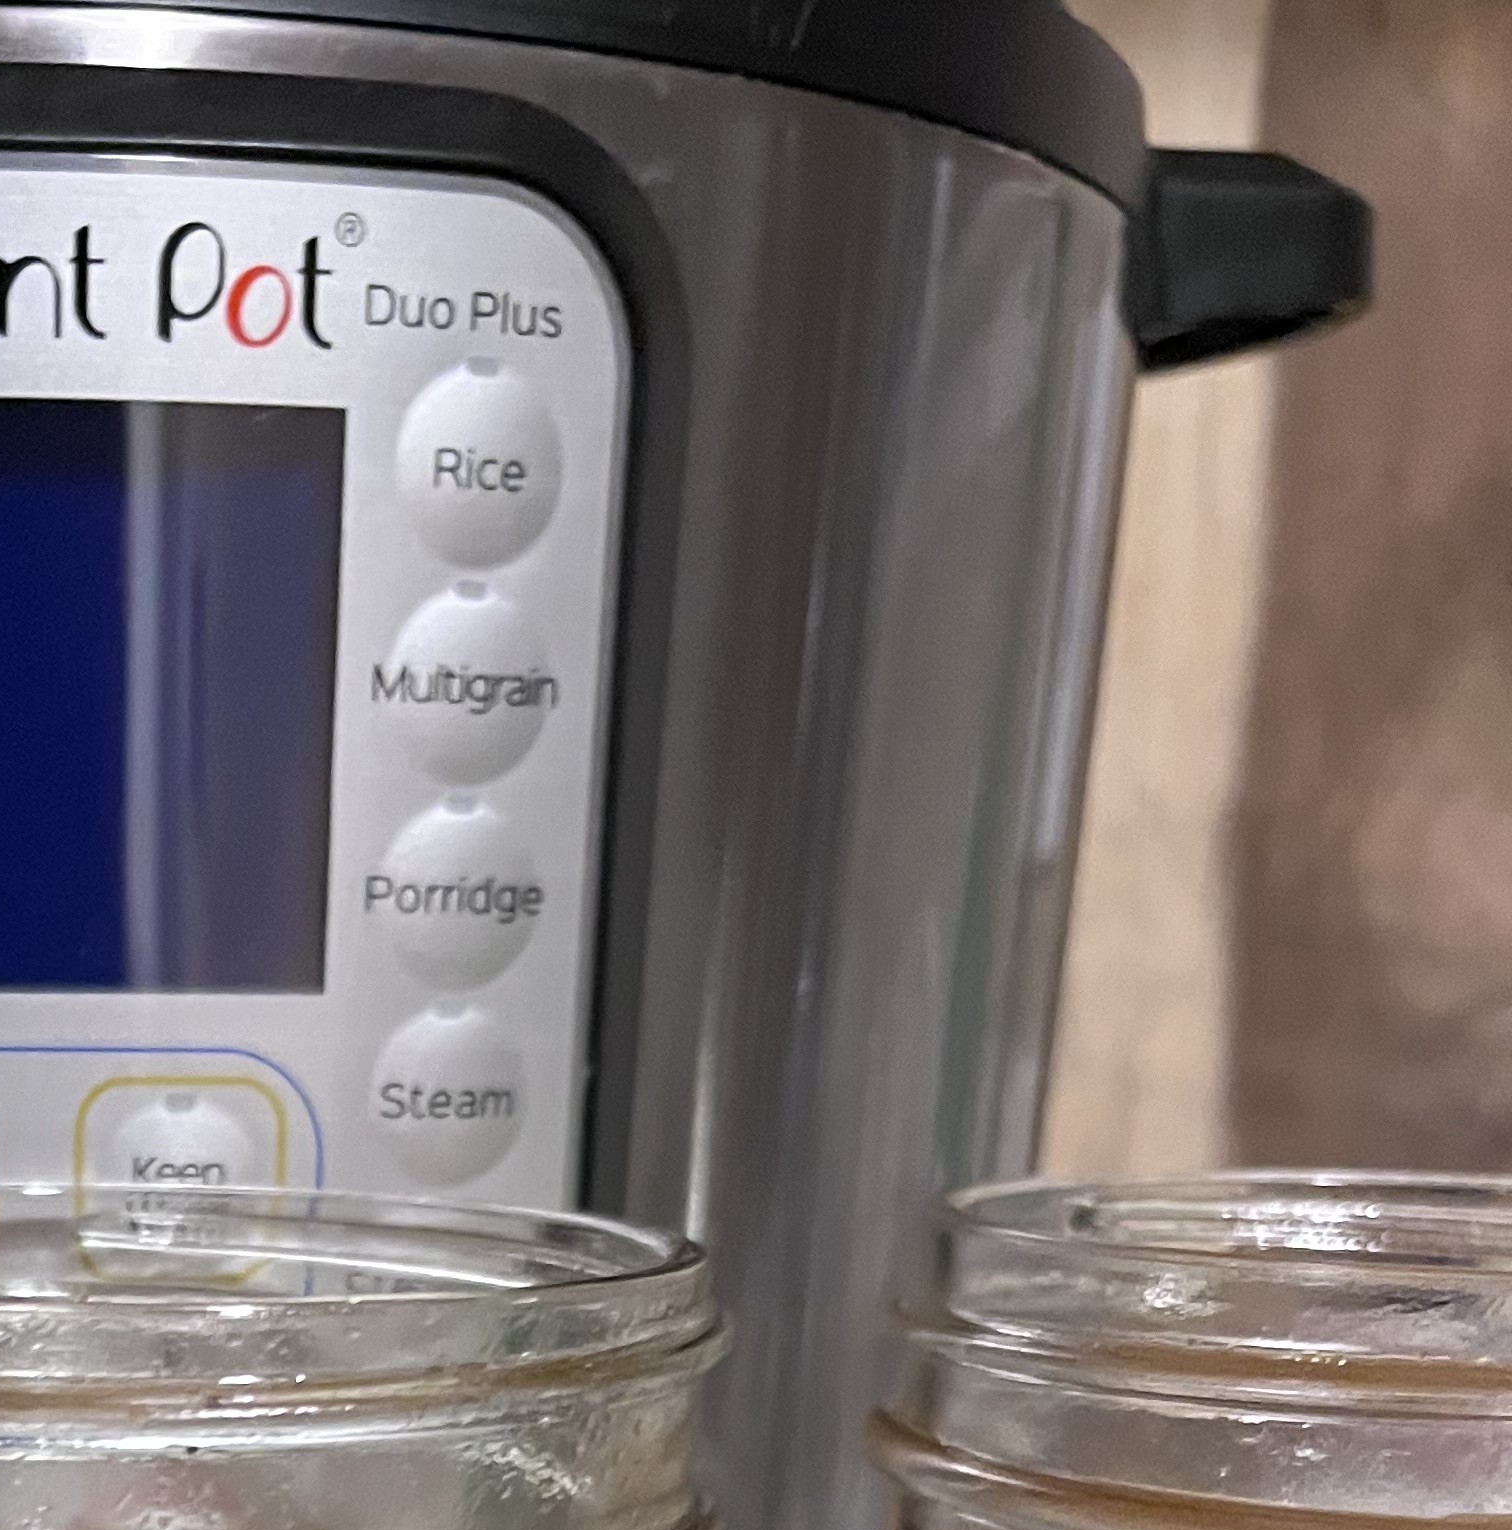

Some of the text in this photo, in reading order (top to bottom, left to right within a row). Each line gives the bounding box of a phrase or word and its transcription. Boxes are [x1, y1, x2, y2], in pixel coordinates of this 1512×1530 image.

[364, 284, 563, 339] Duo Plus
[433, 447, 527, 492] Rice
[370, 663, 559, 715] Multigrain
[364, 874, 544, 924] Porridge
[380, 1082, 515, 1120] Steam
